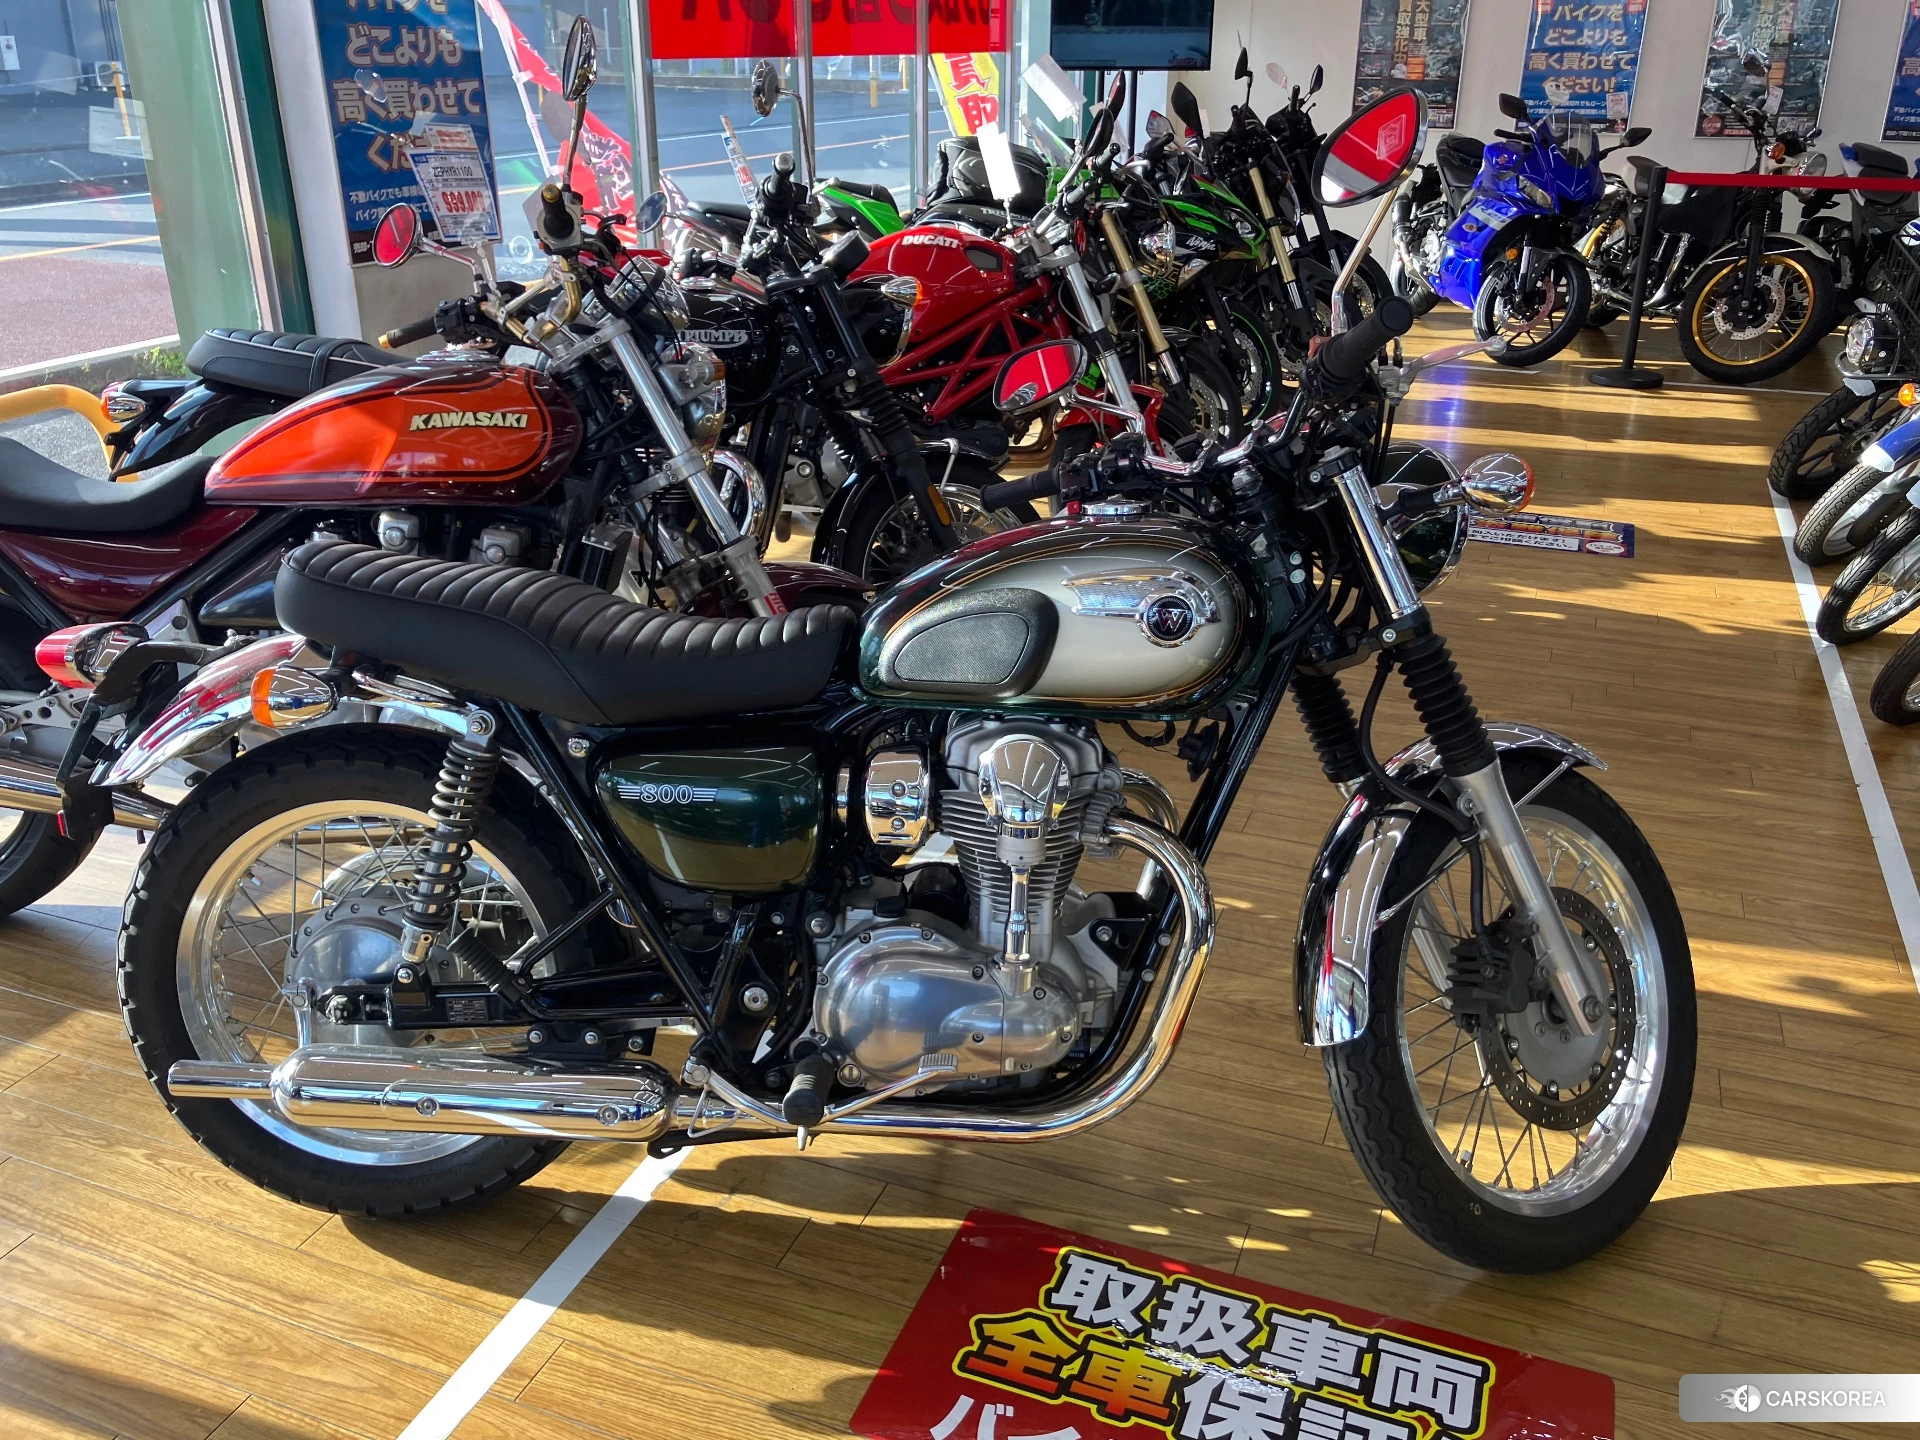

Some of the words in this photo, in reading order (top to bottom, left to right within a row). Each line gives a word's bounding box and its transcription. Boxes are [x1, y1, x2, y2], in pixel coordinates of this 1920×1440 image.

[1412, 1, 1430, 41] 大型車
[1553, 4, 1624, 22] バイクを
[347, 24, 462, 65] どこよりも
[1544, 27, 1628, 46] どこよりも
[1529, 52, 1635, 70] 高く買わせて
[332, 80, 481, 122] 高く買わせて
[368, 133, 430, 170] くだ
[433, 166, 473, 177] ZEPHYR1100
[901, 234, 960, 250] DUCATI
[1186, 235, 1216, 251] Ninja
[410, 411, 529, 431] KAWASAKI
[1152, 608, 1189, 632] W
[640, 783, 693, 804] 800
[1048, 1250, 1483, 1430] 取扱車両
